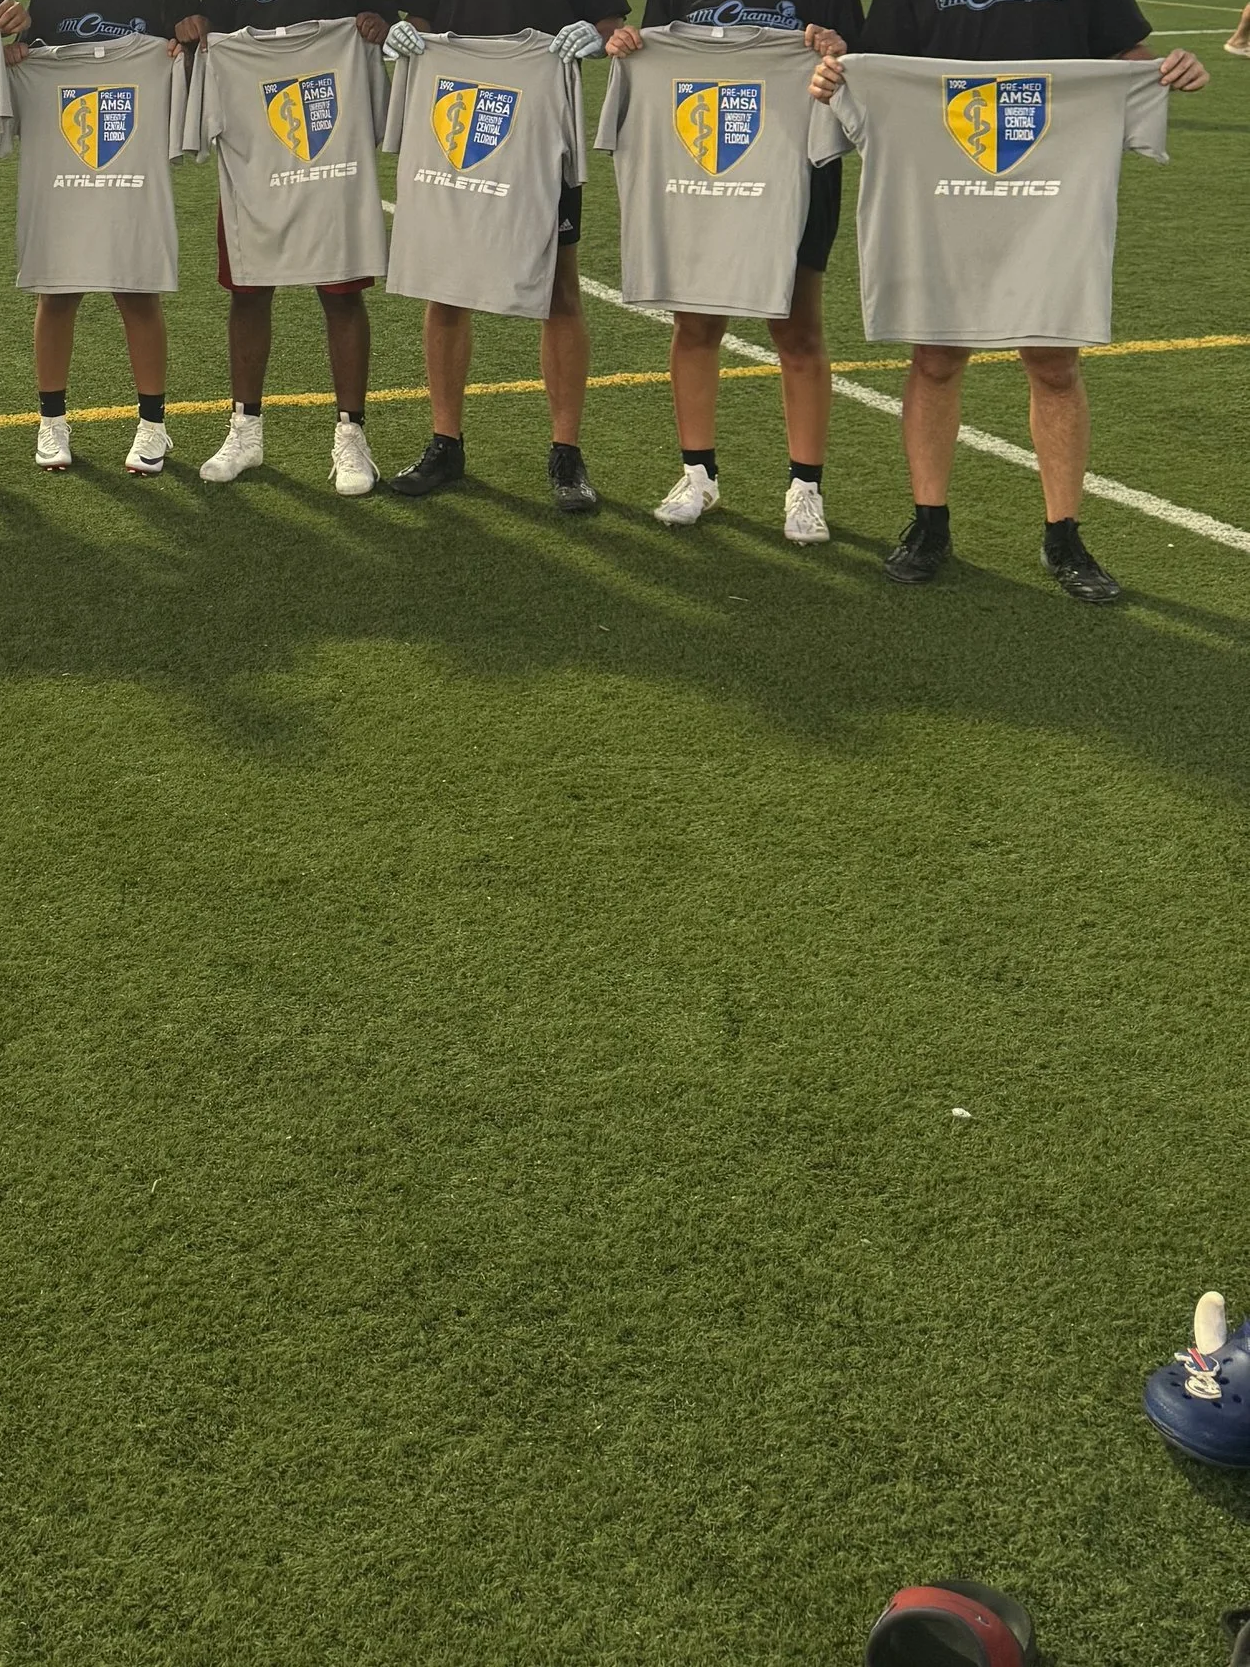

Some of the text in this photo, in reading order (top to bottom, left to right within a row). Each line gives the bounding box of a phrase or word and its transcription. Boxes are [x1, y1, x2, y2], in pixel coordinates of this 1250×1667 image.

[264, 84, 278, 94] 1992
[301, 78, 332, 90] PRE-MED
[440, 80, 454, 91] 1992
[678, 83, 693, 94] 1992
[949, 80, 967, 89] 1992
[1000, 83, 1042, 91] PRE-MED
[63, 89, 76, 99] 1992
[100, 92, 132, 100] PRE-MED
[303, 87, 335, 101] AMSA
[479, 90, 514, 104] PRE-MED
[721, 87, 758, 97] PRE-MED
[999, 91, 1042, 103] AMSA
[100, 100, 132, 111] AMSA
[476, 99, 510, 114] AMSA
[720, 97, 758, 110] AMSA
[310, 109, 332, 121] CENTRAL
[103, 121, 127, 131] CENTRAL
[311, 120, 332, 132] FLORIDA
[724, 122, 752, 133] CENTRAL
[1004, 116, 1036, 128] CENTRAL
[476, 122, 501, 135] CENTRAL
[103, 132, 125, 142] FLORIDA
[473, 132, 498, 146] FLORIDA
[724, 133, 750, 145] FLORIDA
[1005, 129, 1035, 141] FLORIDA
[269, 161, 358, 187] ATHLETICS
[53, 174, 145, 188] ATHLETICS
[413, 168, 511, 197] ATHLETICS
[665, 179, 767, 197] ATHLETICS
[934, 179, 1062, 196] ATHLETICS
